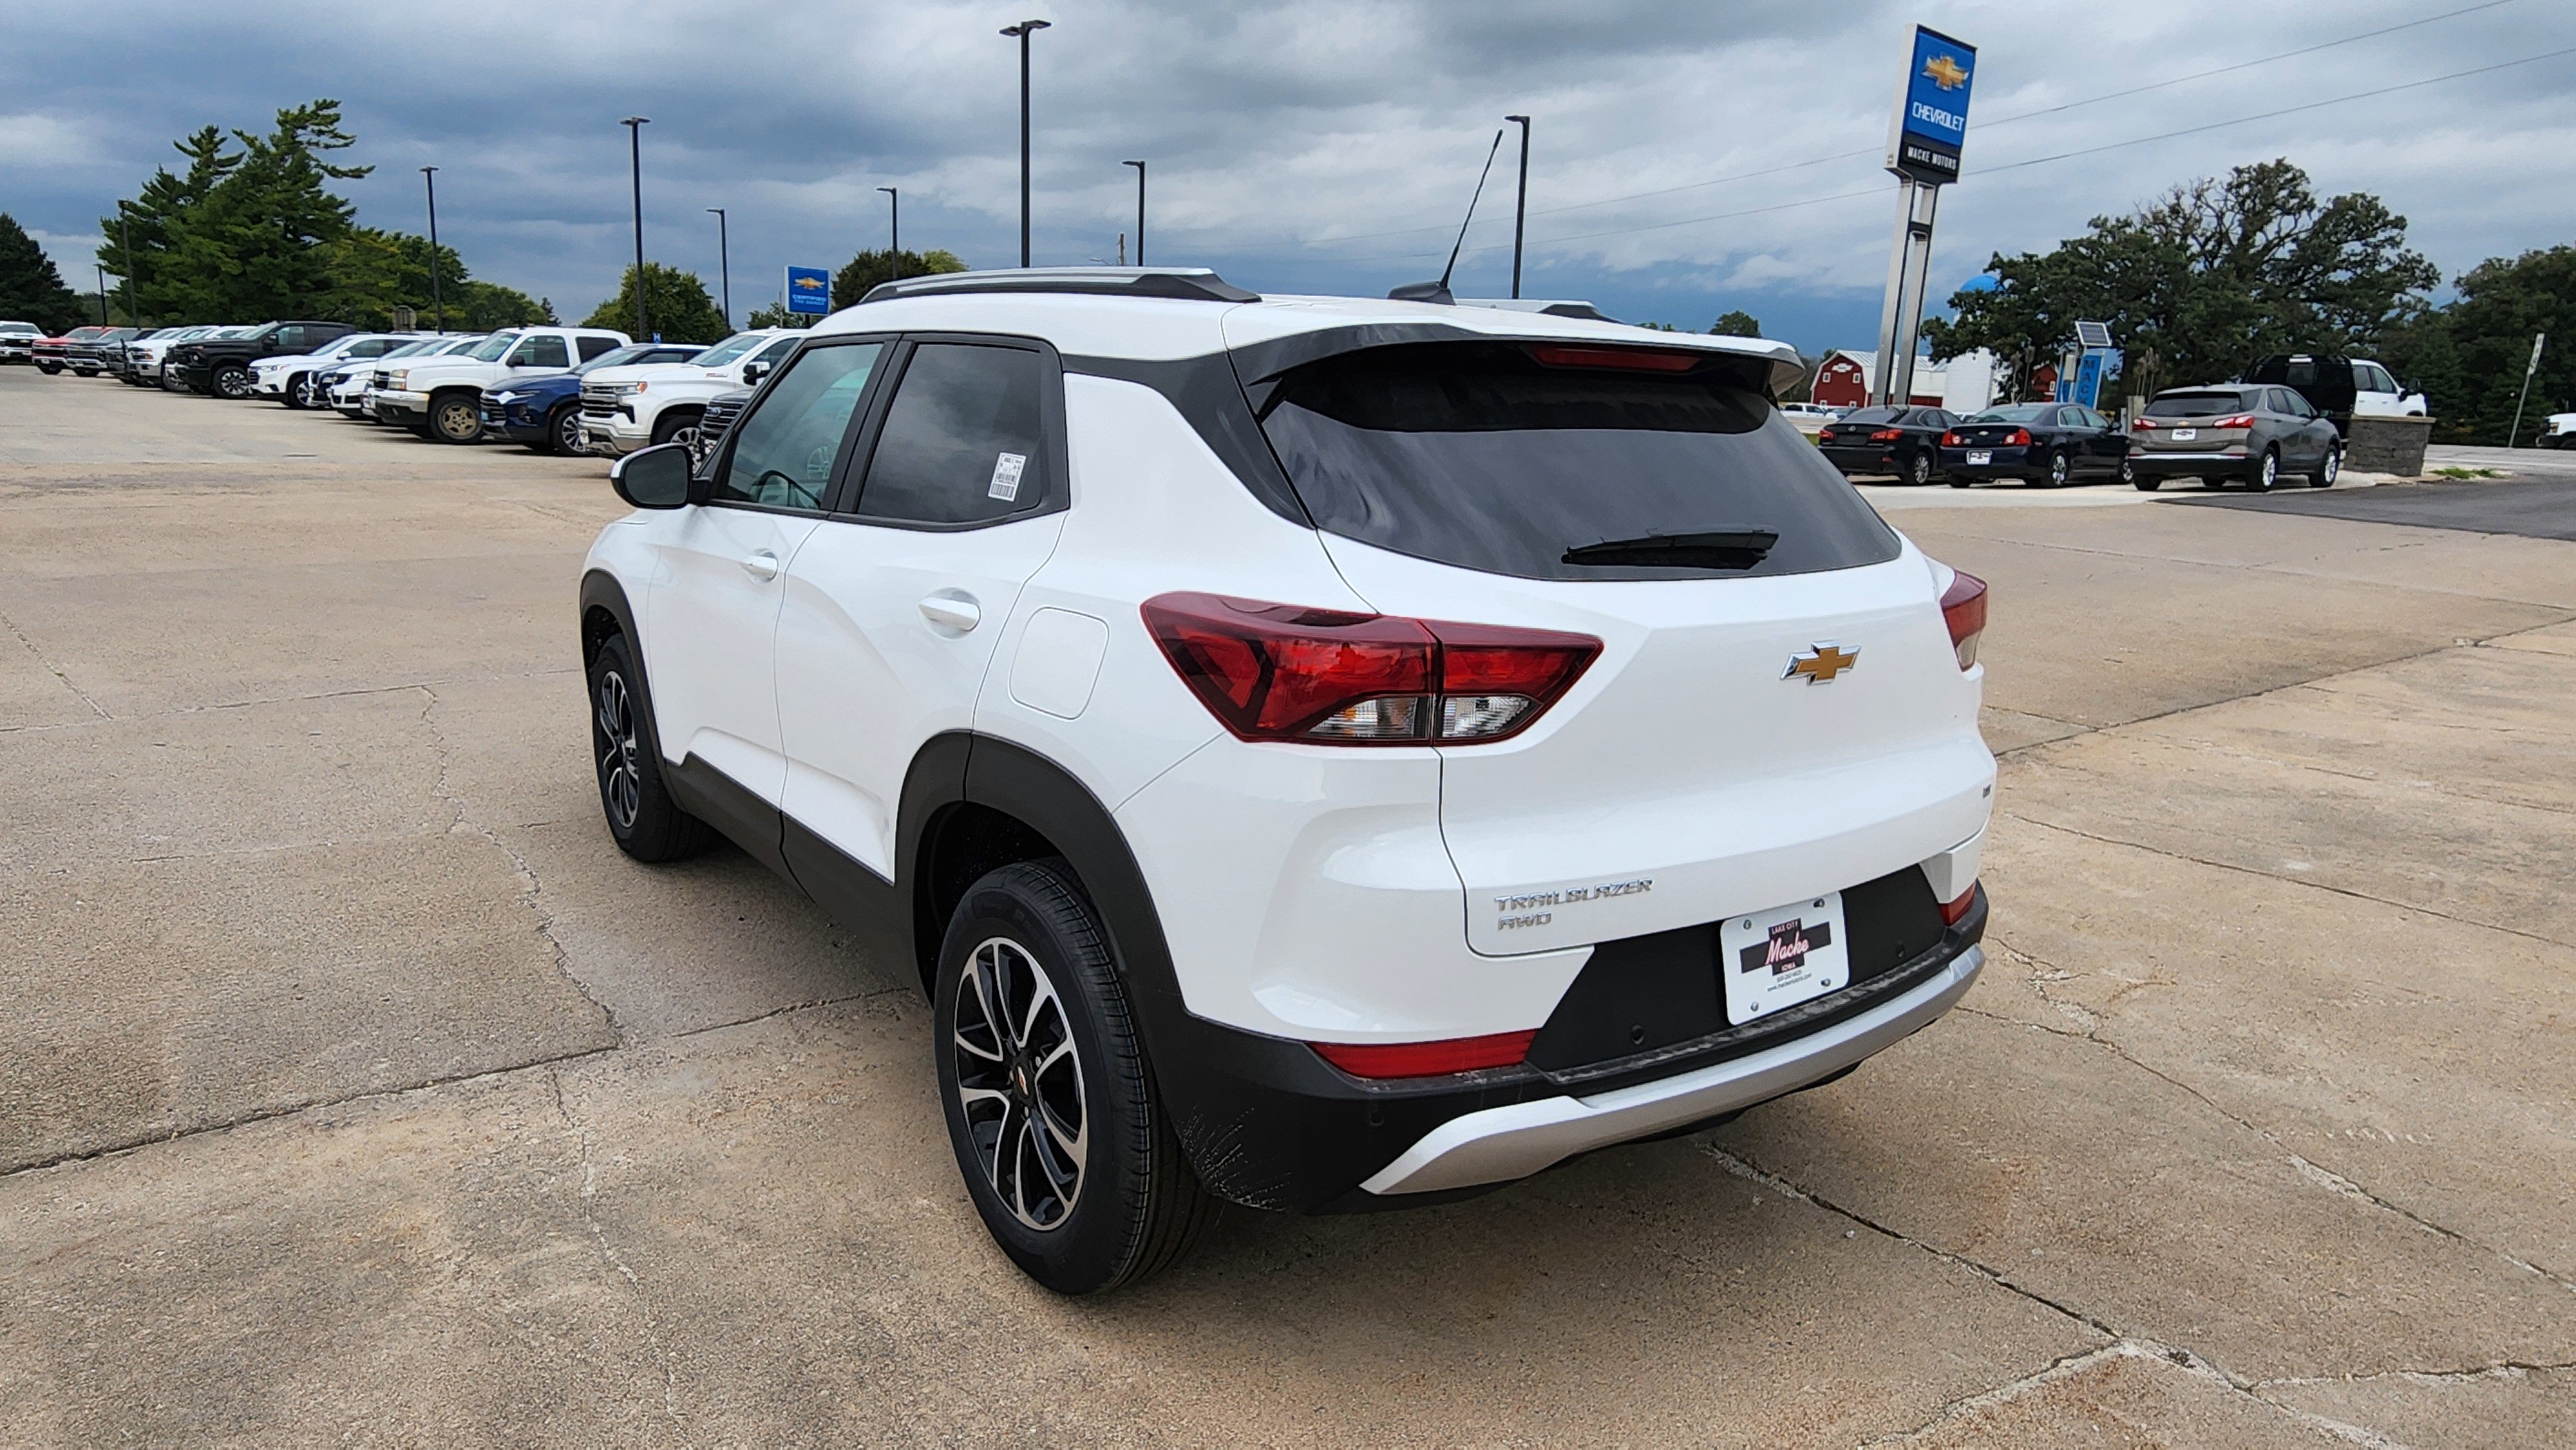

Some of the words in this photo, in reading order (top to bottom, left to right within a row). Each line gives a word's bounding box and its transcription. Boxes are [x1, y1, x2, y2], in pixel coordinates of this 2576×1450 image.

[1912, 101, 1965, 131] CHEVROLET
[1908, 146, 1930, 163] MACKE
[1931, 153, 1956, 170] MOTORS
[1494, 878, 1653, 911] TRAILBLAZER
[1498, 911, 1552, 930] AWD
[1772, 926, 1786, 934] LAKE
[1786, 921, 1798, 930] CITY
[1765, 930, 1810, 966] Macke
